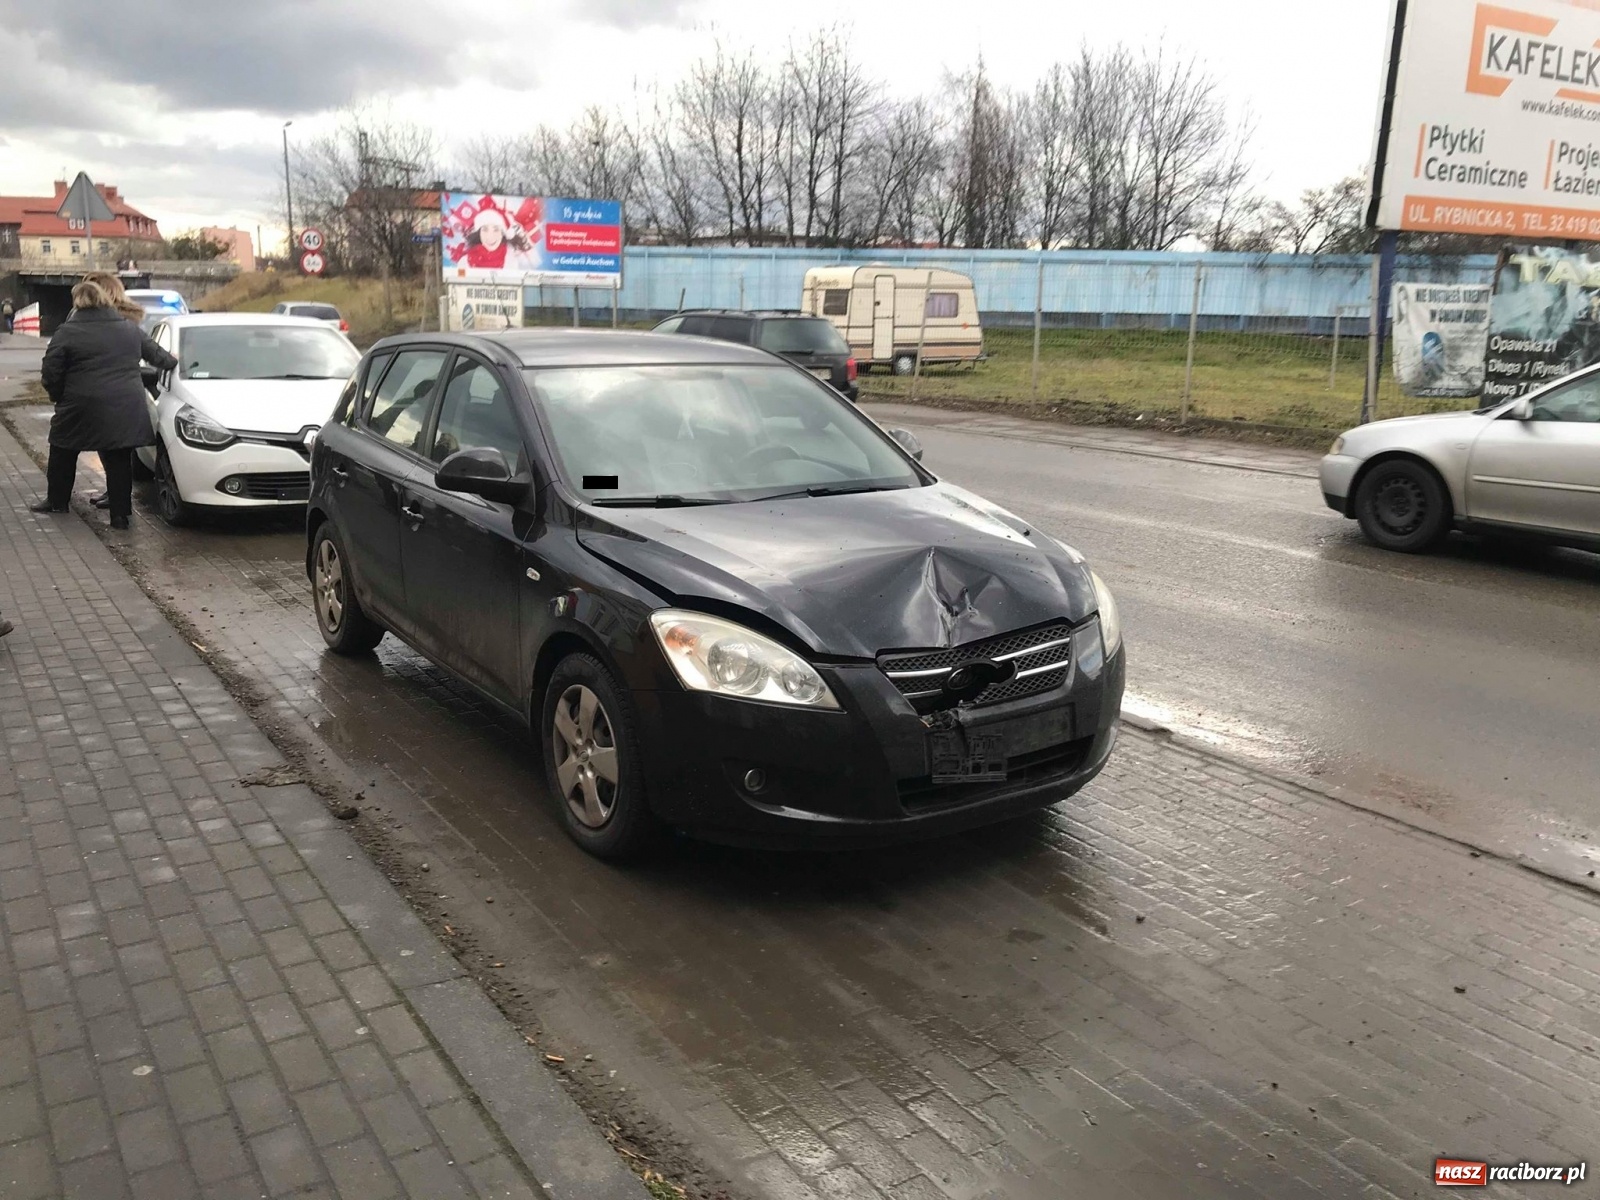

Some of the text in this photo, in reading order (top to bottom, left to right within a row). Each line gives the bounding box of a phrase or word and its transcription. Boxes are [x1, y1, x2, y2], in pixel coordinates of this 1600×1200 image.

[1485, 32, 1600, 88] KAFELEK
[1428, 124, 1485, 156] Płytki
[1557, 141, 1600, 172] Proje
[1424, 156, 1529, 189] Ceramiczne
[1408, 203, 1430, 223] UL.
[1433, 205, 1503, 227] RYBNICKA
[1522, 212, 1547, 231] TEL.
[1549, 213, 1565, 232] 32
[1565, 215, 1587, 233] 419
[304, 234, 320, 246] 40
[585, 255, 615, 267] Auchan
[1490, 335, 1543, 354] Opawska
[1523, 360, 1531, 374] 1
[1484, 381, 1517, 396] Nowa
[1518, 382, 1528, 396] 7
